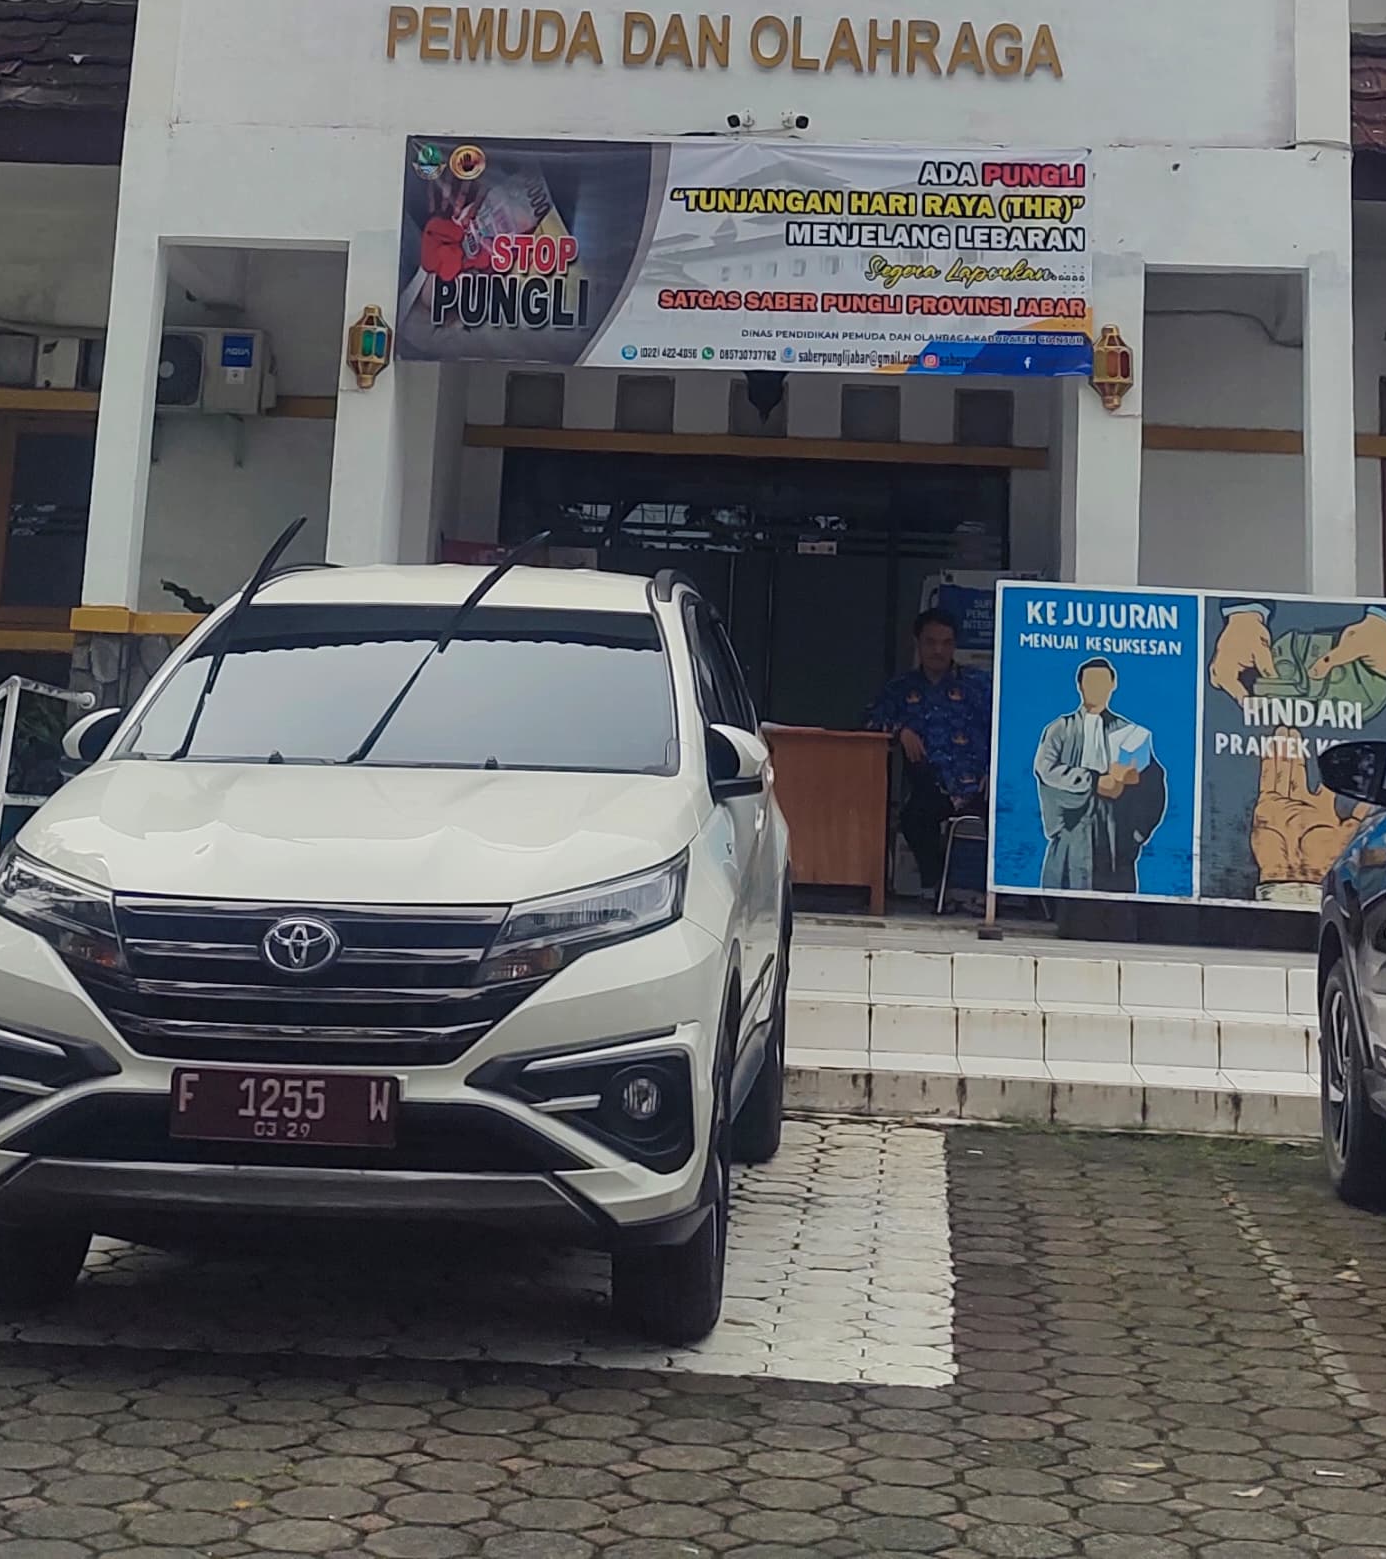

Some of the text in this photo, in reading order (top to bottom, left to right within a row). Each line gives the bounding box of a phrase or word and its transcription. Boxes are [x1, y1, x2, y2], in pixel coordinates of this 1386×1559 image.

[386, 6, 1064, 78] PEMUDA DAN OLAHRAGA
[919, 162, 1086, 188] ADA PUNGLI
[849, 191, 917, 216] HARI
[923, 193, 995, 218] RAYA
[787, 222, 1086, 252] MENJELANG LEBARAN
[492, 233, 579, 274] STOP
[865, 255, 941, 288] Segera
[432, 274, 590, 328] PUNGLI
[659, 289, 1086, 317] SATGAS SABER PUNGLI PROVINSI JABAR
[741, 329, 773, 338] DINAS
[775, 330, 839, 340] PENDIDIKAN
[842, 331, 886, 341] PEMUDA
[889, 332, 911, 341] DAN
[1019, 633, 1182, 656] MENUAI KESUKSESAN
[1243, 696, 1363, 730] HINDARI
[1215, 732, 1311, 759] PRAKTEK
[178, 1073, 391, 1122] F 1255 W
